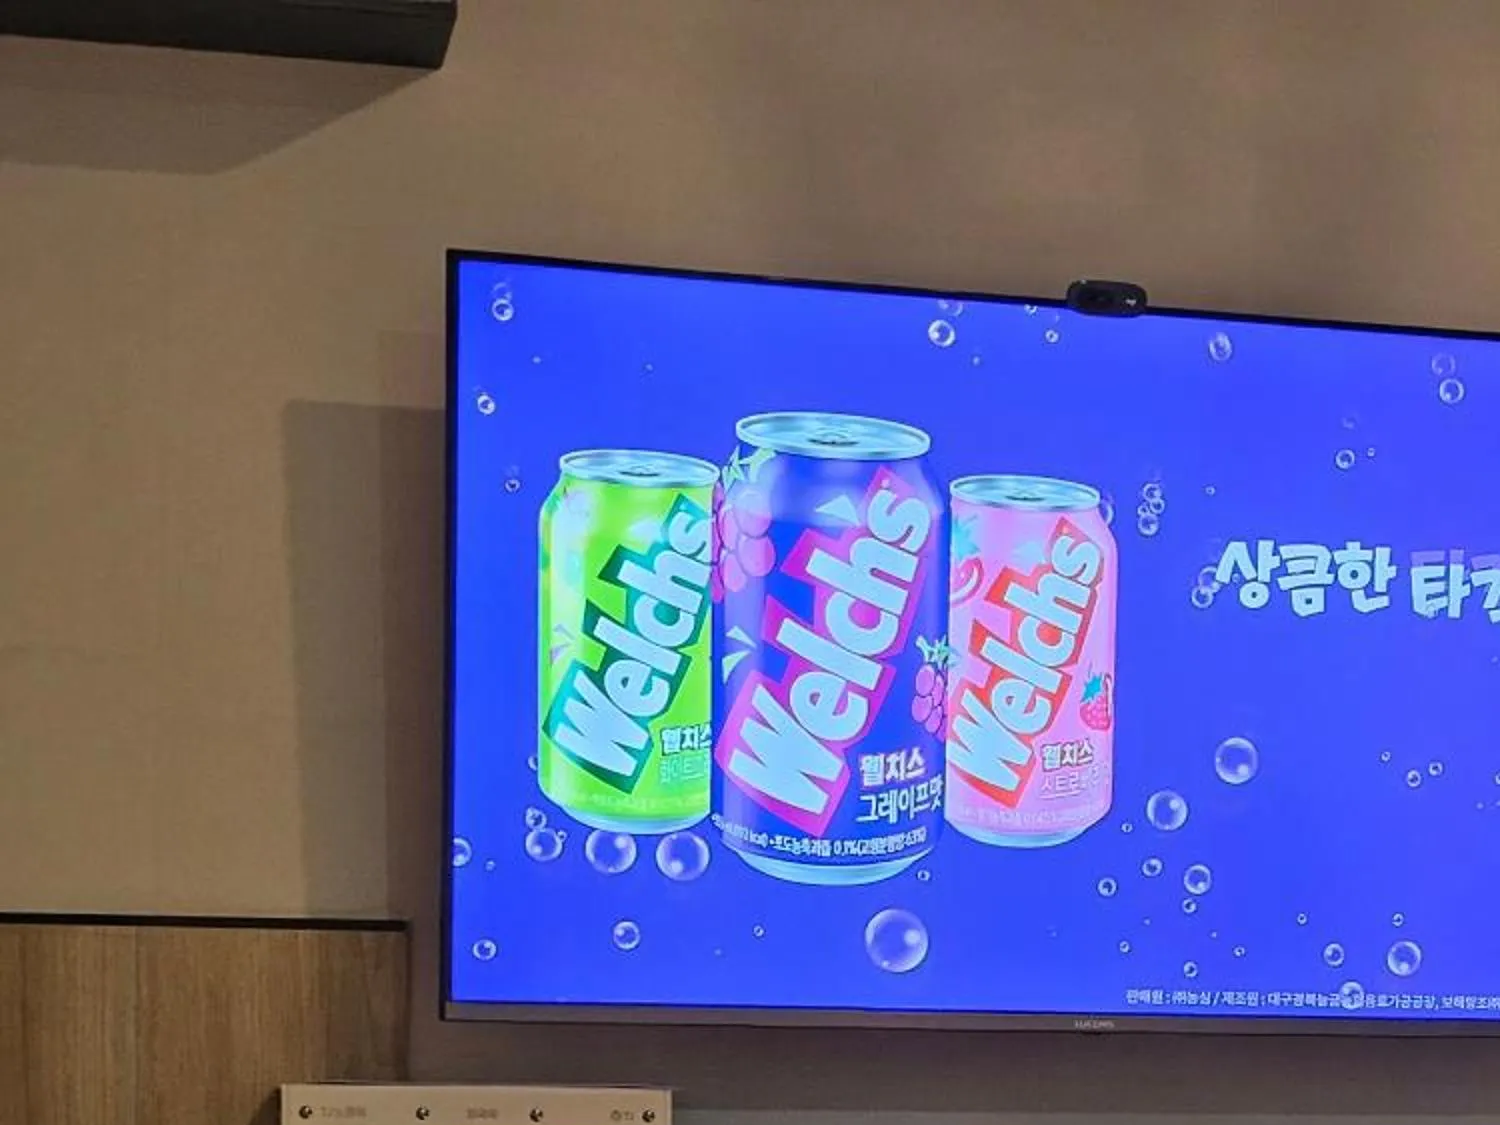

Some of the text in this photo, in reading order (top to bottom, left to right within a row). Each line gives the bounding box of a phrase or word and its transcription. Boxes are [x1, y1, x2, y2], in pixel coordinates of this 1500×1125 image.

[1215, 538, 1397, 618] 상큼한
[860, 746, 926, 785] 웰치스
[1041, 738, 1095, 771] 웰치스
